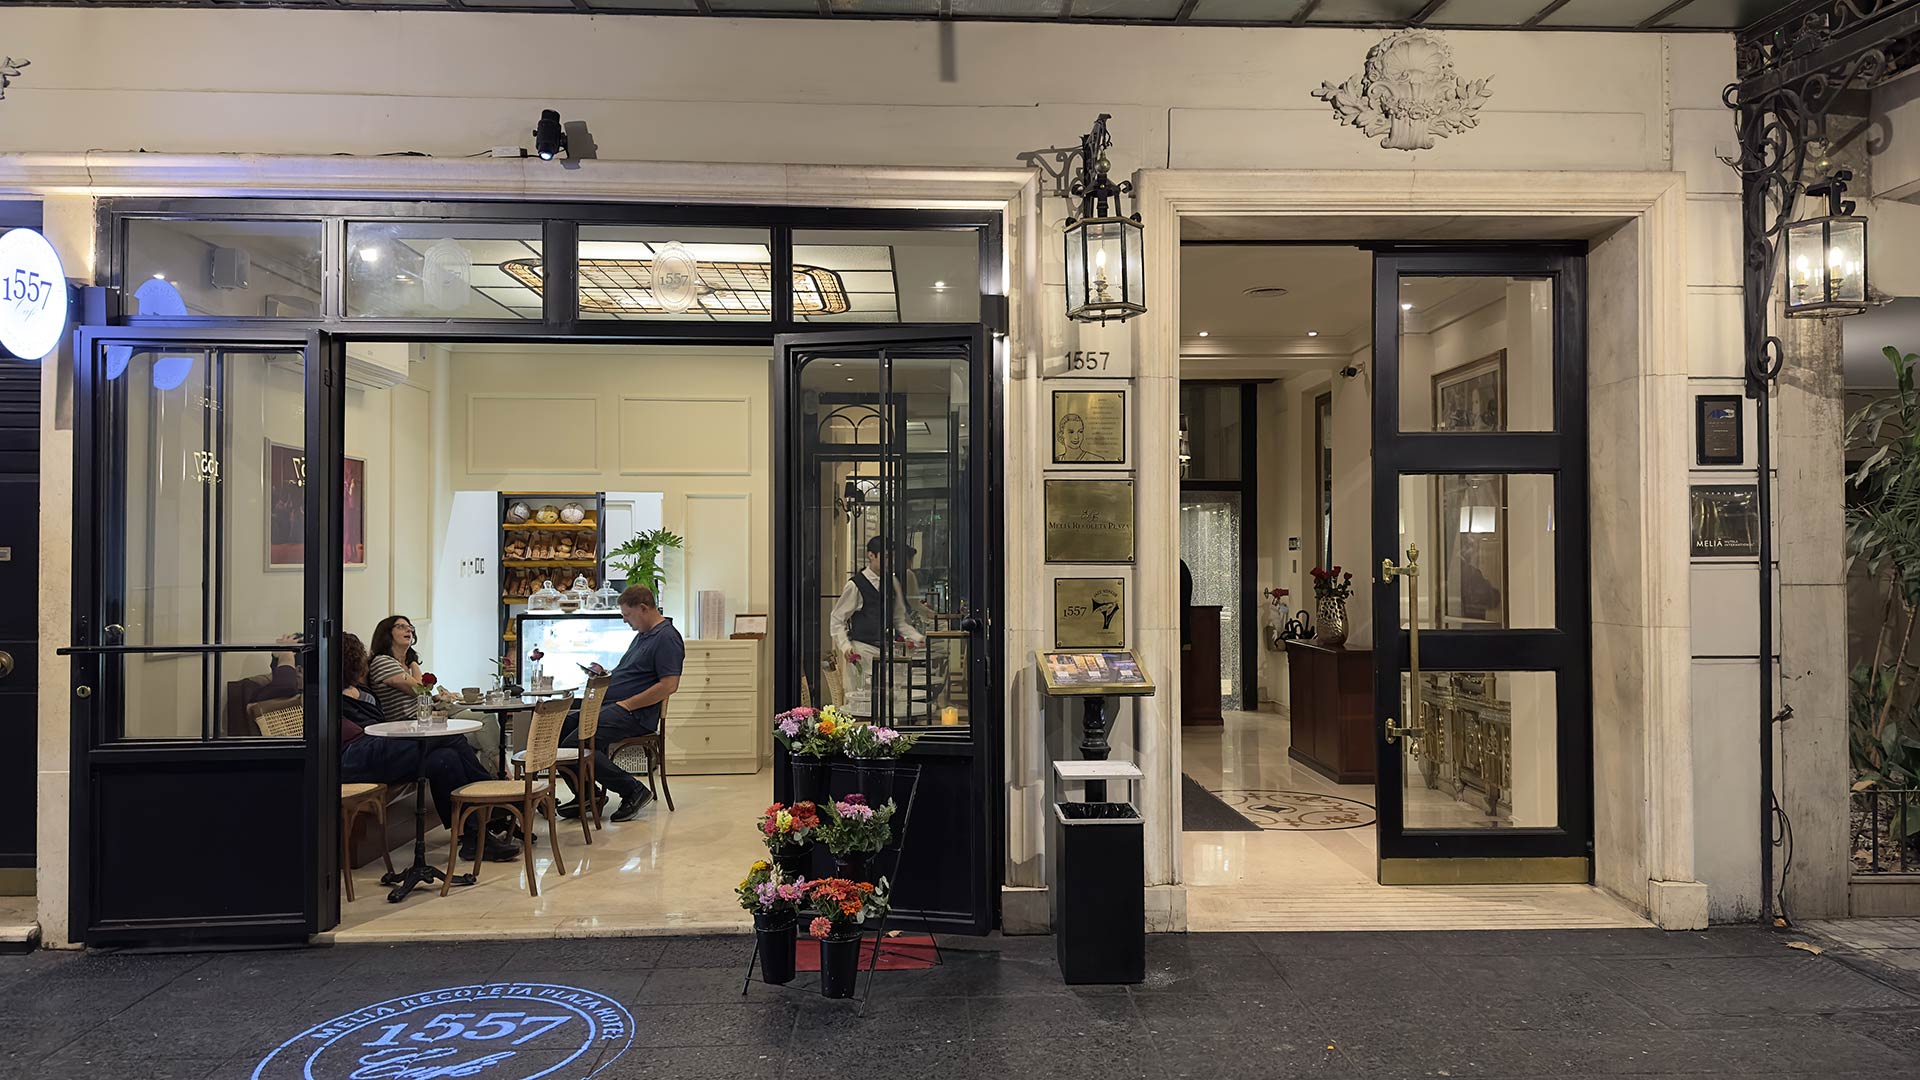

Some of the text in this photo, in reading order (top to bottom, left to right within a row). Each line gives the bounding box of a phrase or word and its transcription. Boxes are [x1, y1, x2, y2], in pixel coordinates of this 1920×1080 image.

[2, 268, 53, 311] 1557
[659, 272, 689, 287] 1557
[1064, 351, 1110, 371] 1557
[1063, 605, 1087, 617] 1557
[310, 1006, 396, 1040] MELIA
[400, 986, 532, 1008] RECOLETA
[538, 988, 602, 1010] PLAZA
[361, 1011, 573, 1046] 1557
